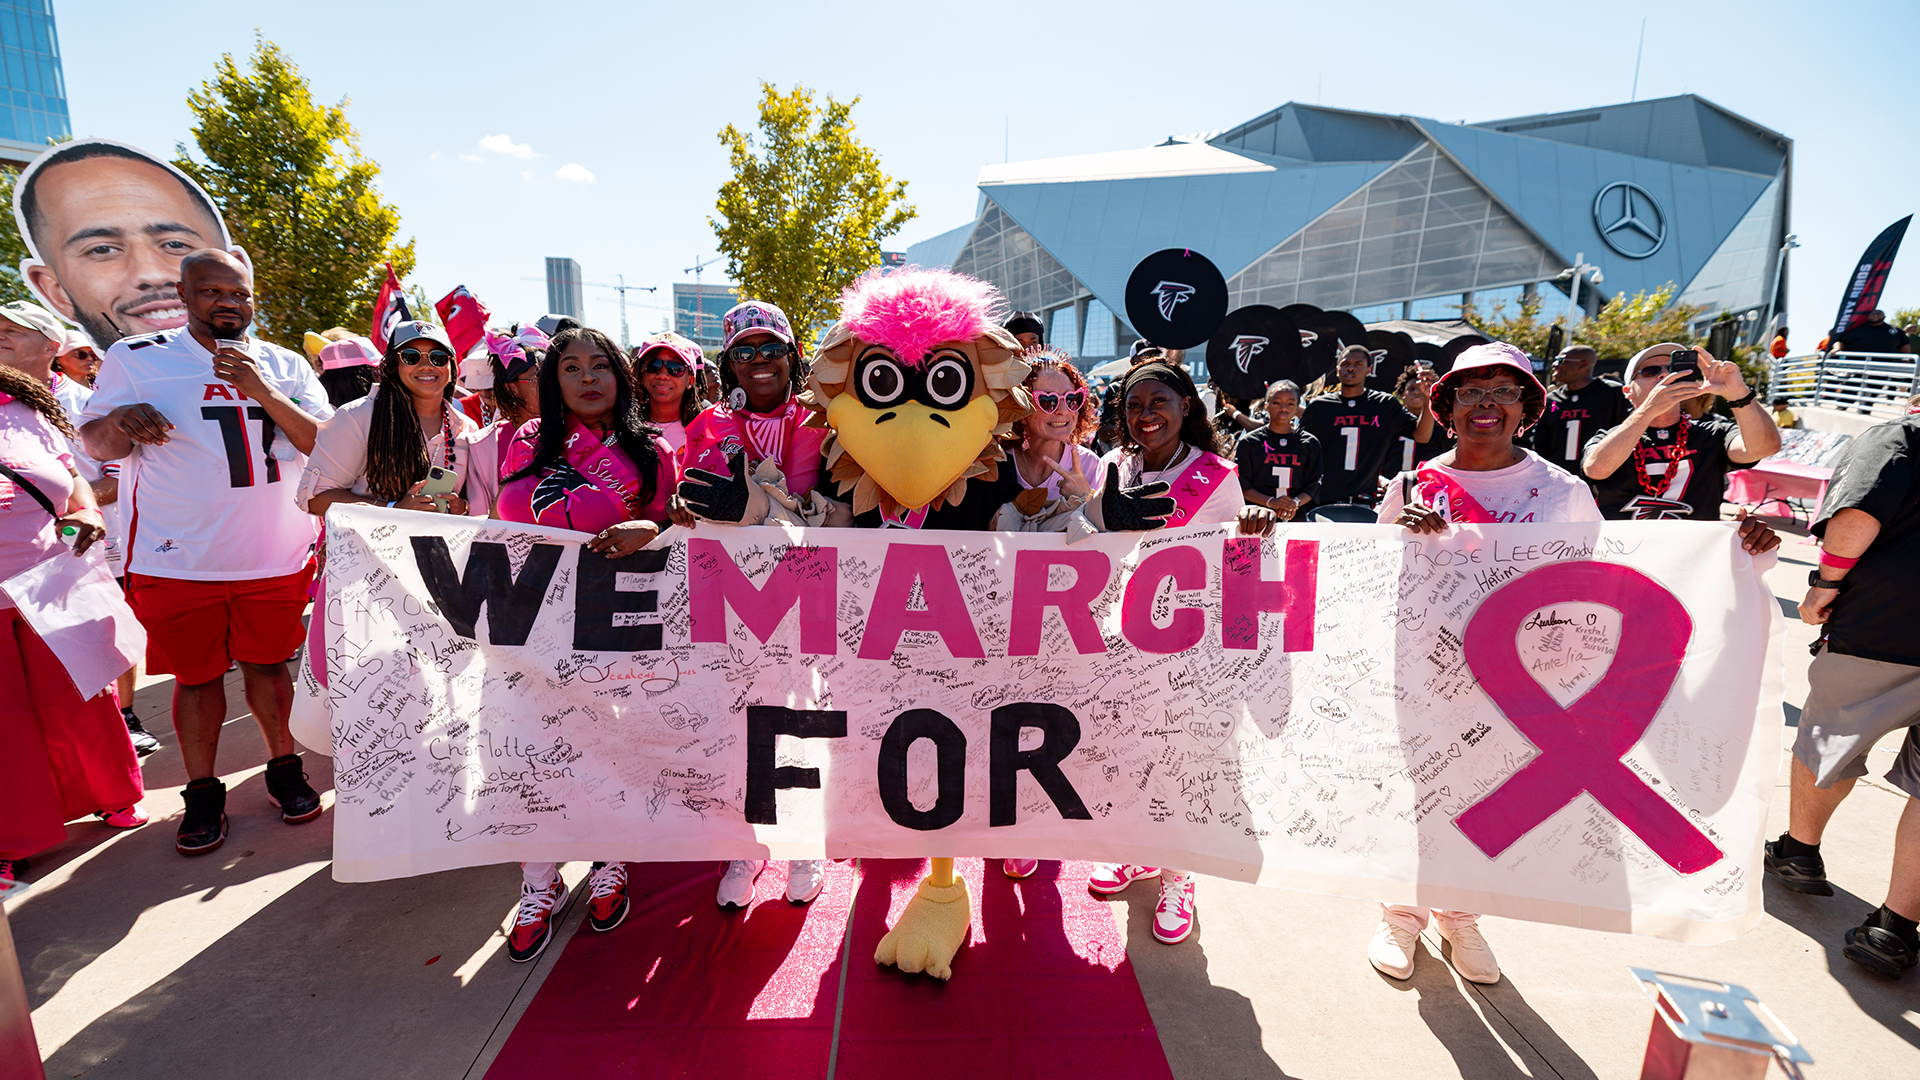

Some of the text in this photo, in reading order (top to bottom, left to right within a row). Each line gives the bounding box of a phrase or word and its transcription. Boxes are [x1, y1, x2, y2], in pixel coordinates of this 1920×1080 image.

[203, 384, 248, 401] AT
[1333, 415, 1369, 426] ATL
[1560, 408, 1591, 420] ATL
[1341, 427, 1361, 471] 1
[1564, 420, 1581, 461] 1
[1264, 453, 1301, 466] ATL
[1272, 466, 1293, 499] 1
[327, 540, 357, 559] NCER
[1140, 537, 1173, 550] DERRICK
[1408, 540, 1482, 567] ROSE
[1494, 540, 1540, 563] LEE
[363, 567, 384, 587] Team
[368, 574, 391, 597] Donna
[960, 565, 998, 587] Fighting
[409, 535, 673, 652] WE
[688, 538, 1320, 661] MARCH
[970, 595, 985, 607] THE
[1128, 653, 1178, 680] Johnson
[1323, 648, 1369, 671] Jayden
[368, 688, 397, 714] Smith
[1116, 679, 1152, 700] Charlotte
[1164, 683, 1238, 726] Nancy Johnson
[430, 732, 537, 761] Charlotte
[462, 763, 575, 785] Robertson
[745, 702, 1091, 831] FOR
[1419, 757, 1453, 785] Hudson
[365, 765, 398, 794] Jacob
